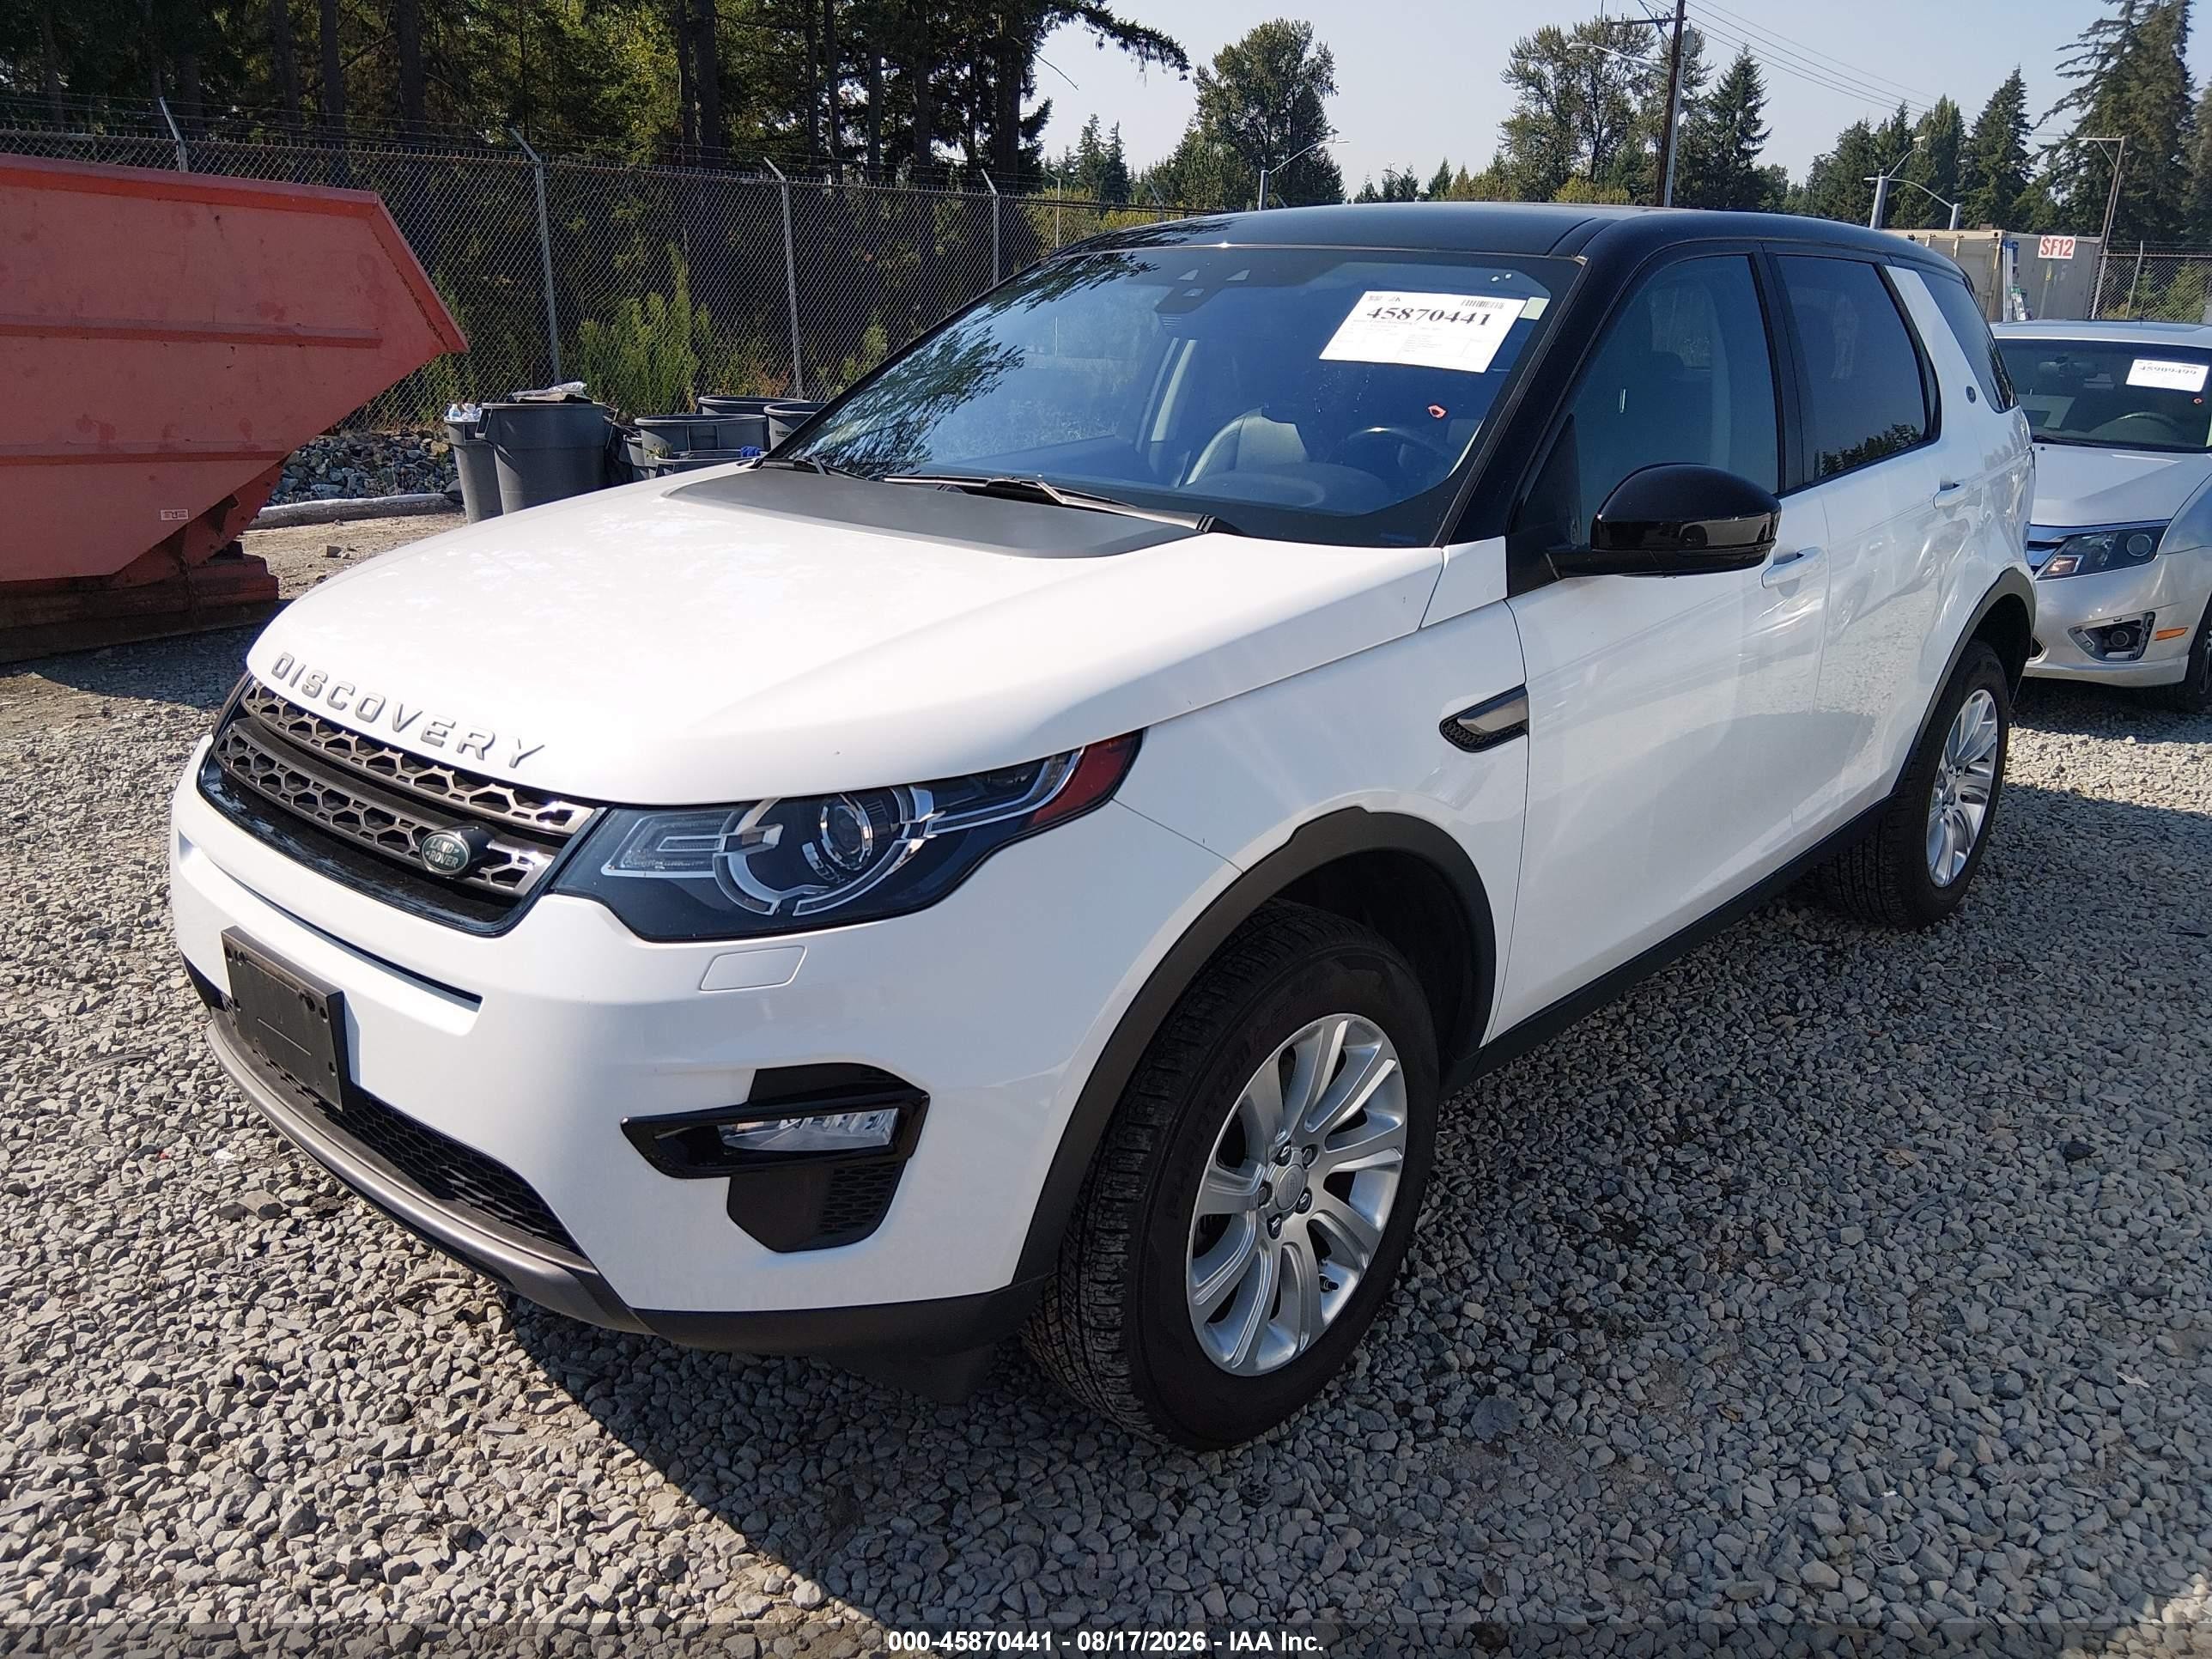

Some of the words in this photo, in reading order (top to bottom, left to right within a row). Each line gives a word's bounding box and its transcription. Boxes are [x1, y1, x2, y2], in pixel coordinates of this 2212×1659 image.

[2041, 237, 2075, 256] SF12
[1366, 306, 1492, 326] 45870441
[271, 652, 545, 769] DISCOVERY
[429, 837, 455, 854] LAND
[428, 850, 459, 868] ROVER
